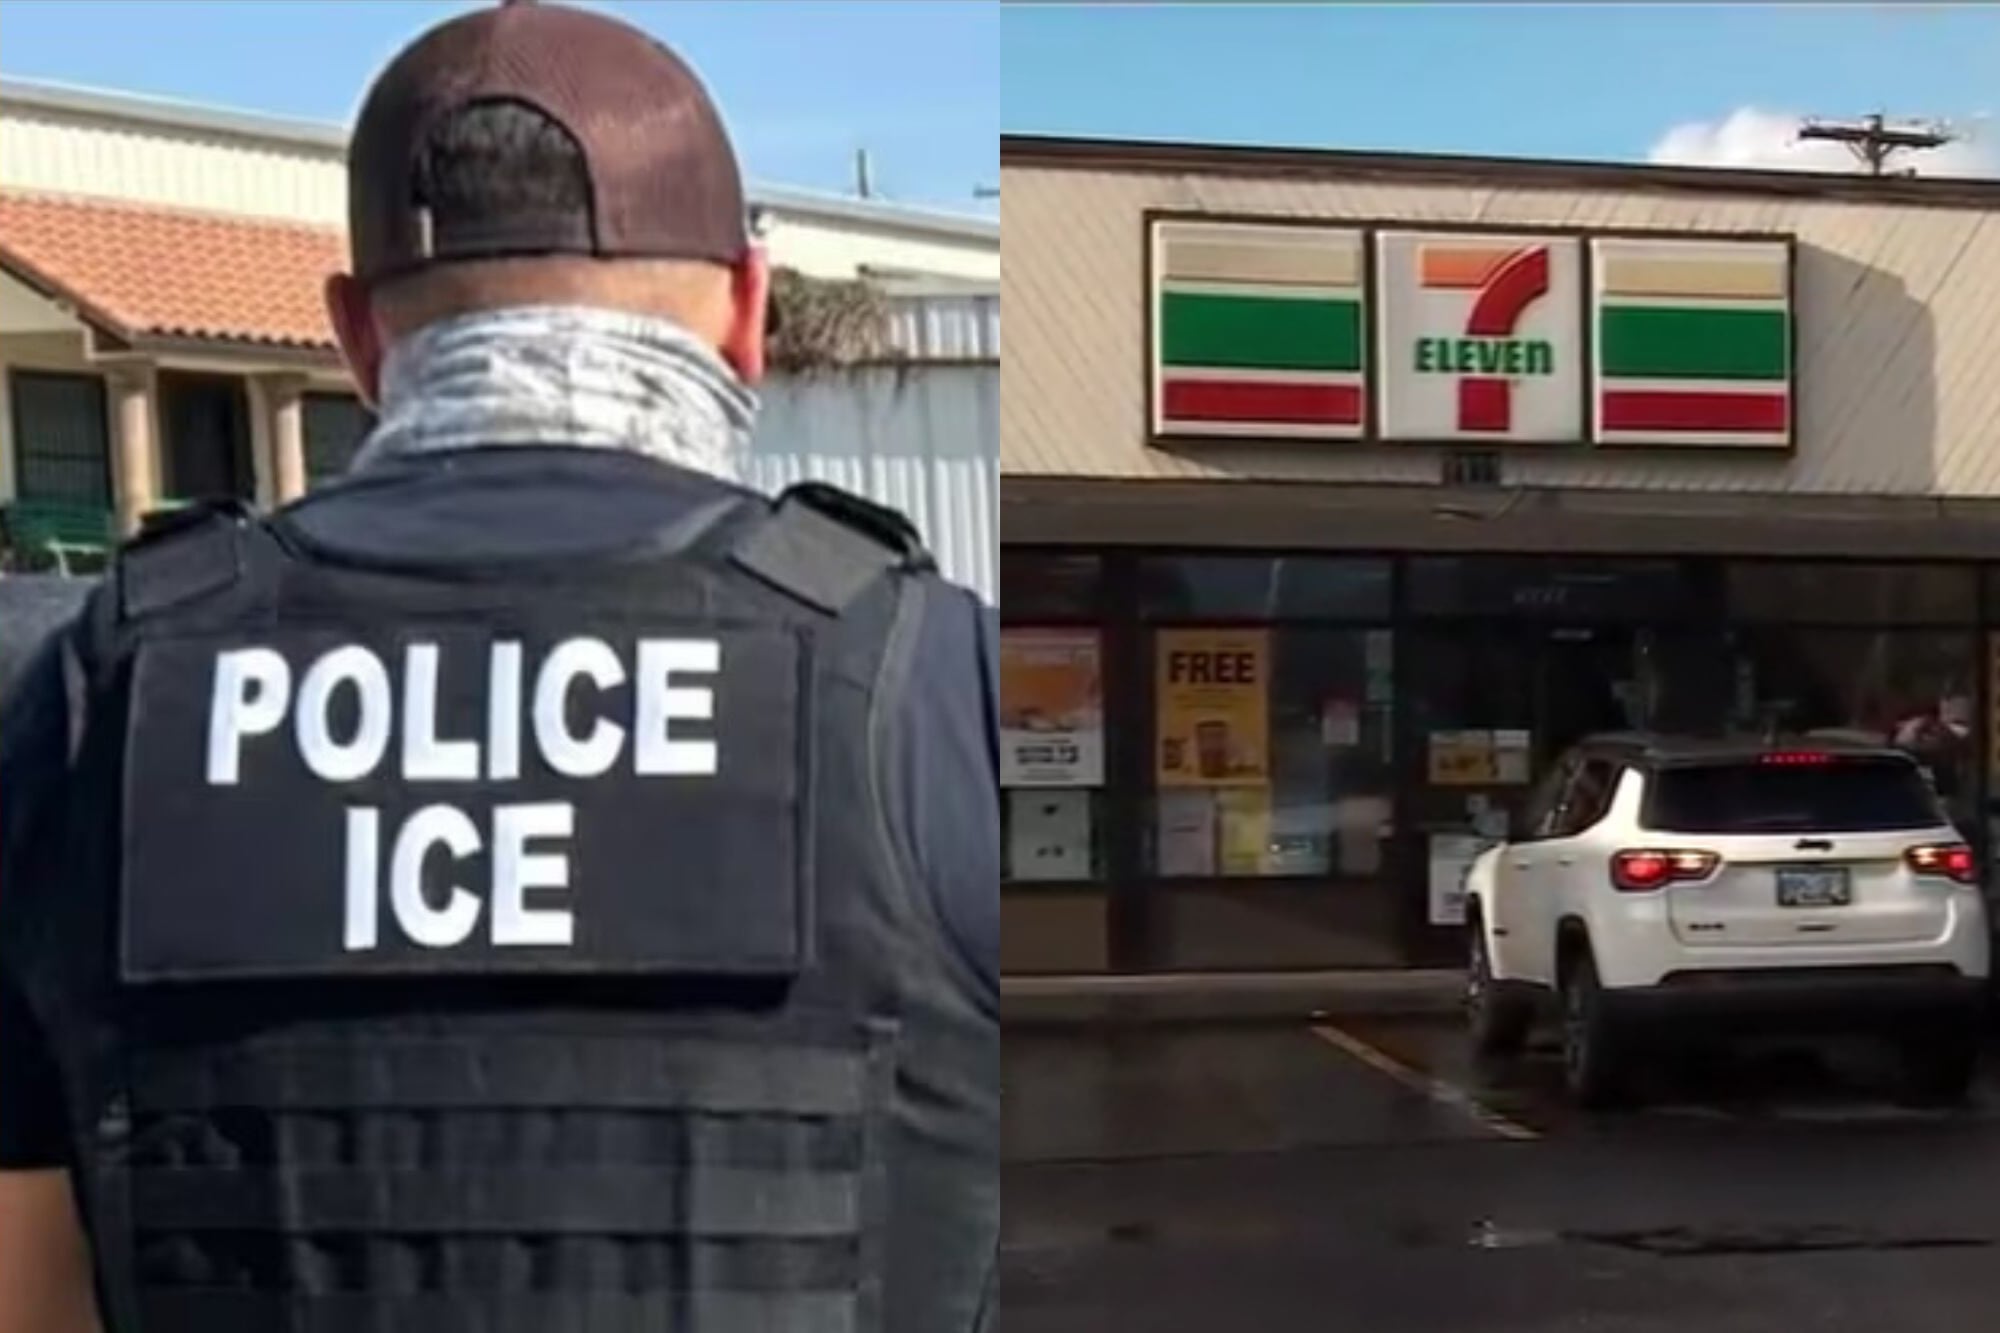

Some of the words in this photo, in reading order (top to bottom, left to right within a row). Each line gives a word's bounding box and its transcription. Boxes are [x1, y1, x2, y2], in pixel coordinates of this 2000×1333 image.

[1420, 247, 1549, 431] 7
[207, 637, 720, 785] POLICE
[1168, 651, 1256, 684] FREE
[343, 802, 574, 950] ICE
